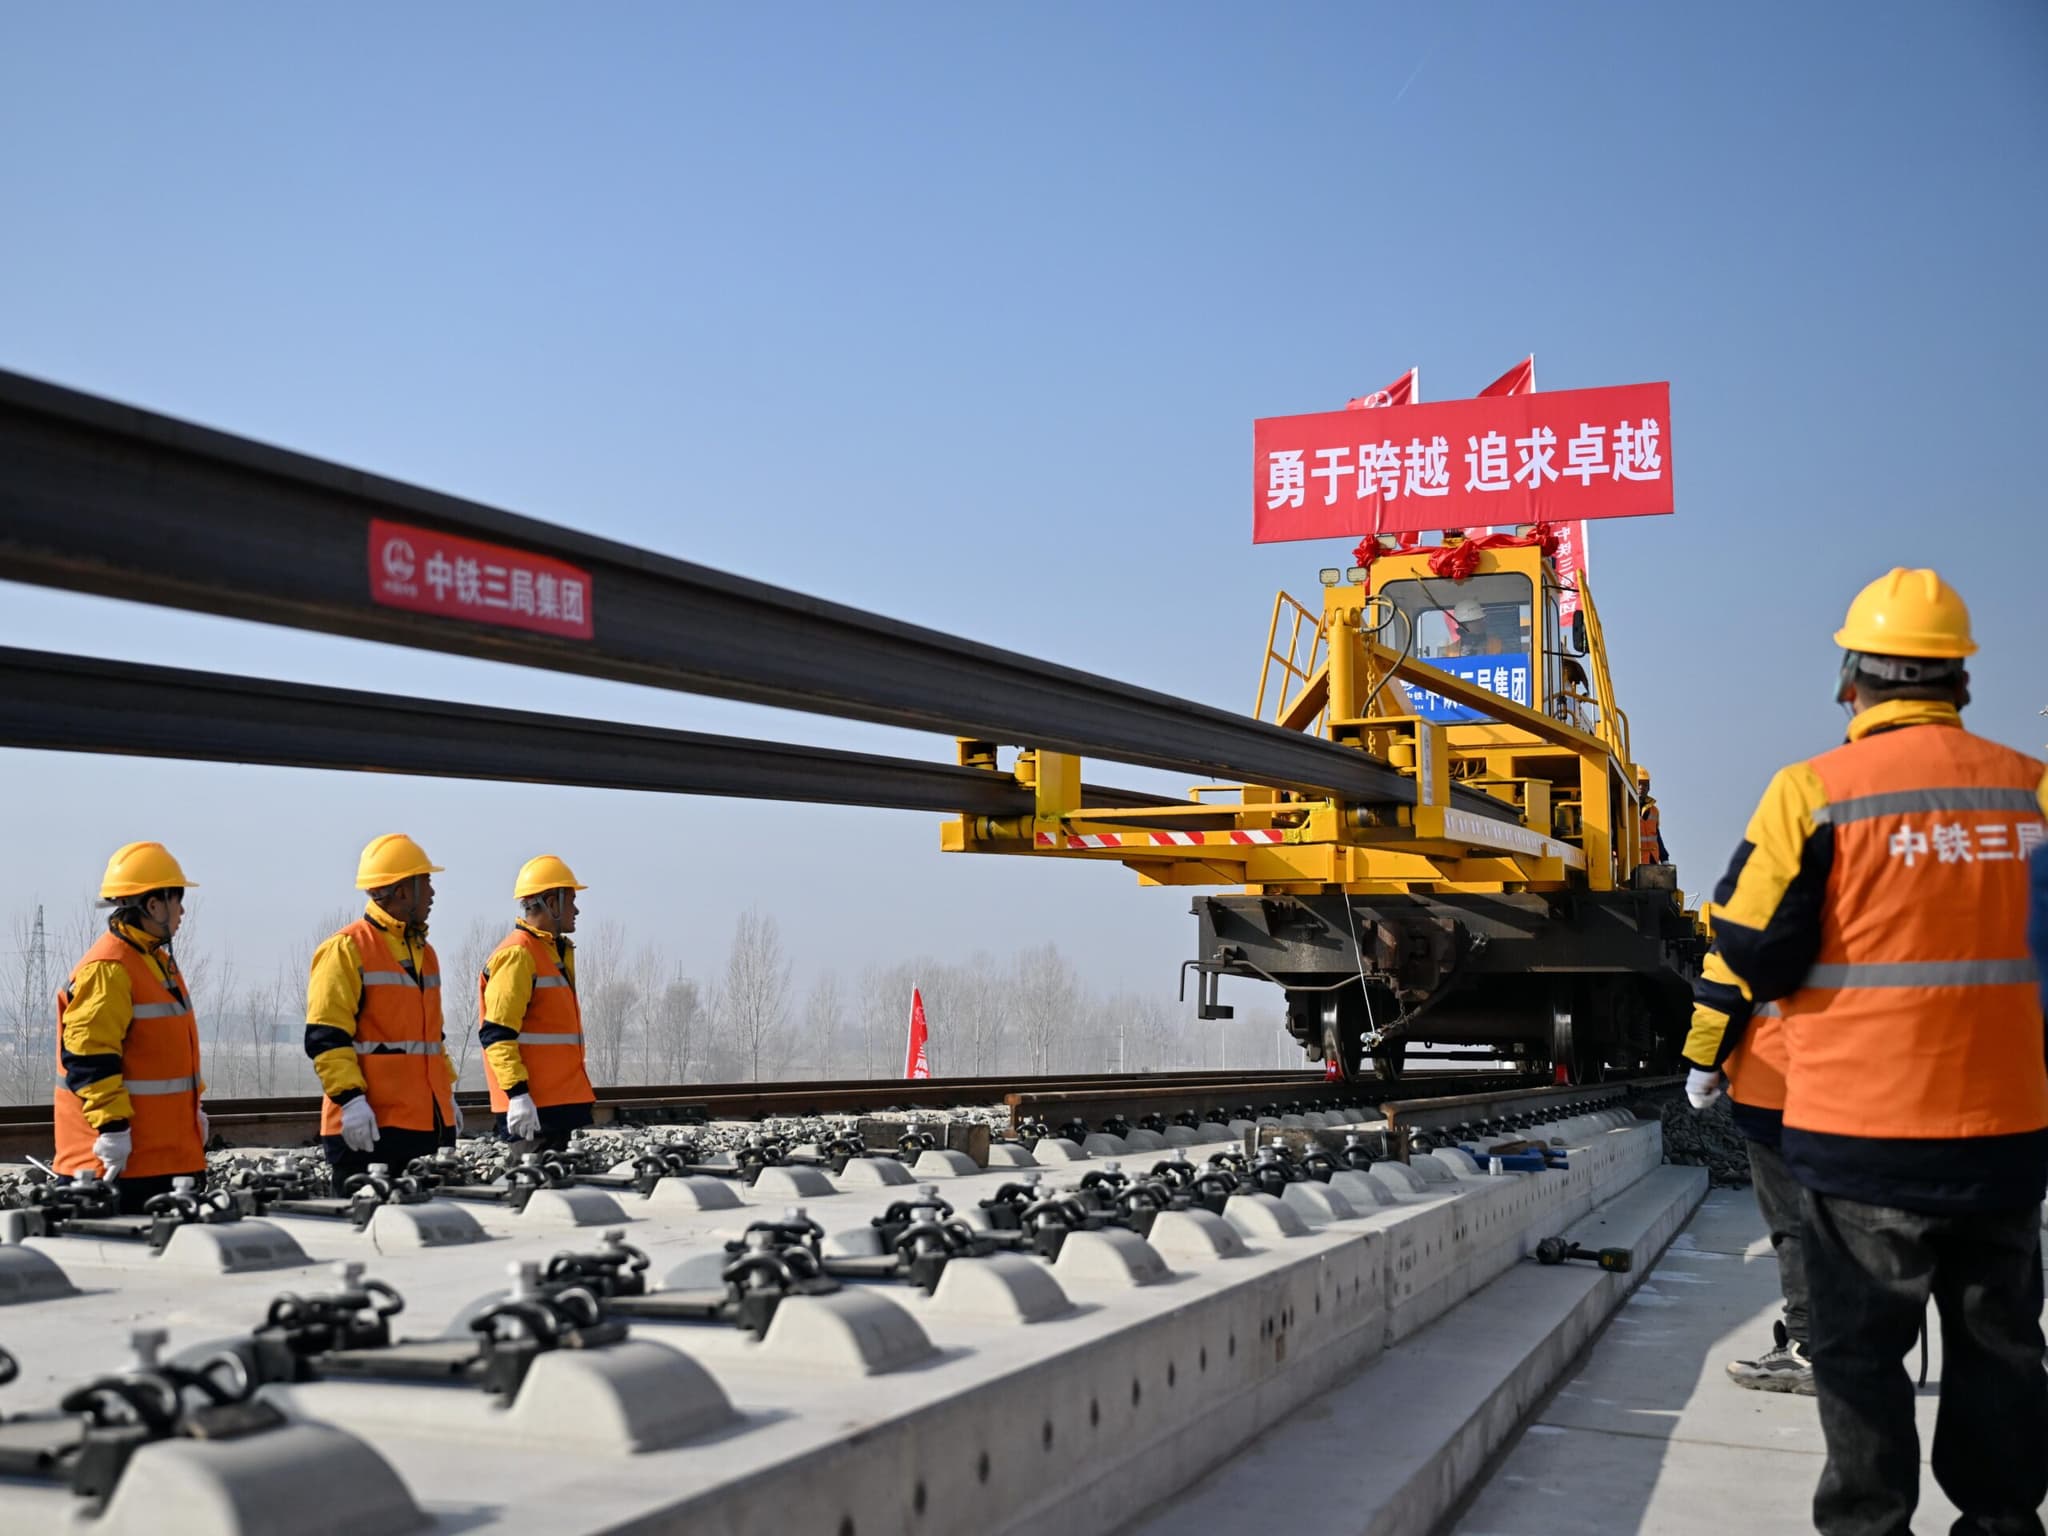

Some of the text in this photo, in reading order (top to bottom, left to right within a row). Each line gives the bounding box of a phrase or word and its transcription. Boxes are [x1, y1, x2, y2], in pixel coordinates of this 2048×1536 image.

[1266, 418, 1662, 510] 勇于跨越 追求卓越
[424, 551, 584, 625] 中铁三局集团
